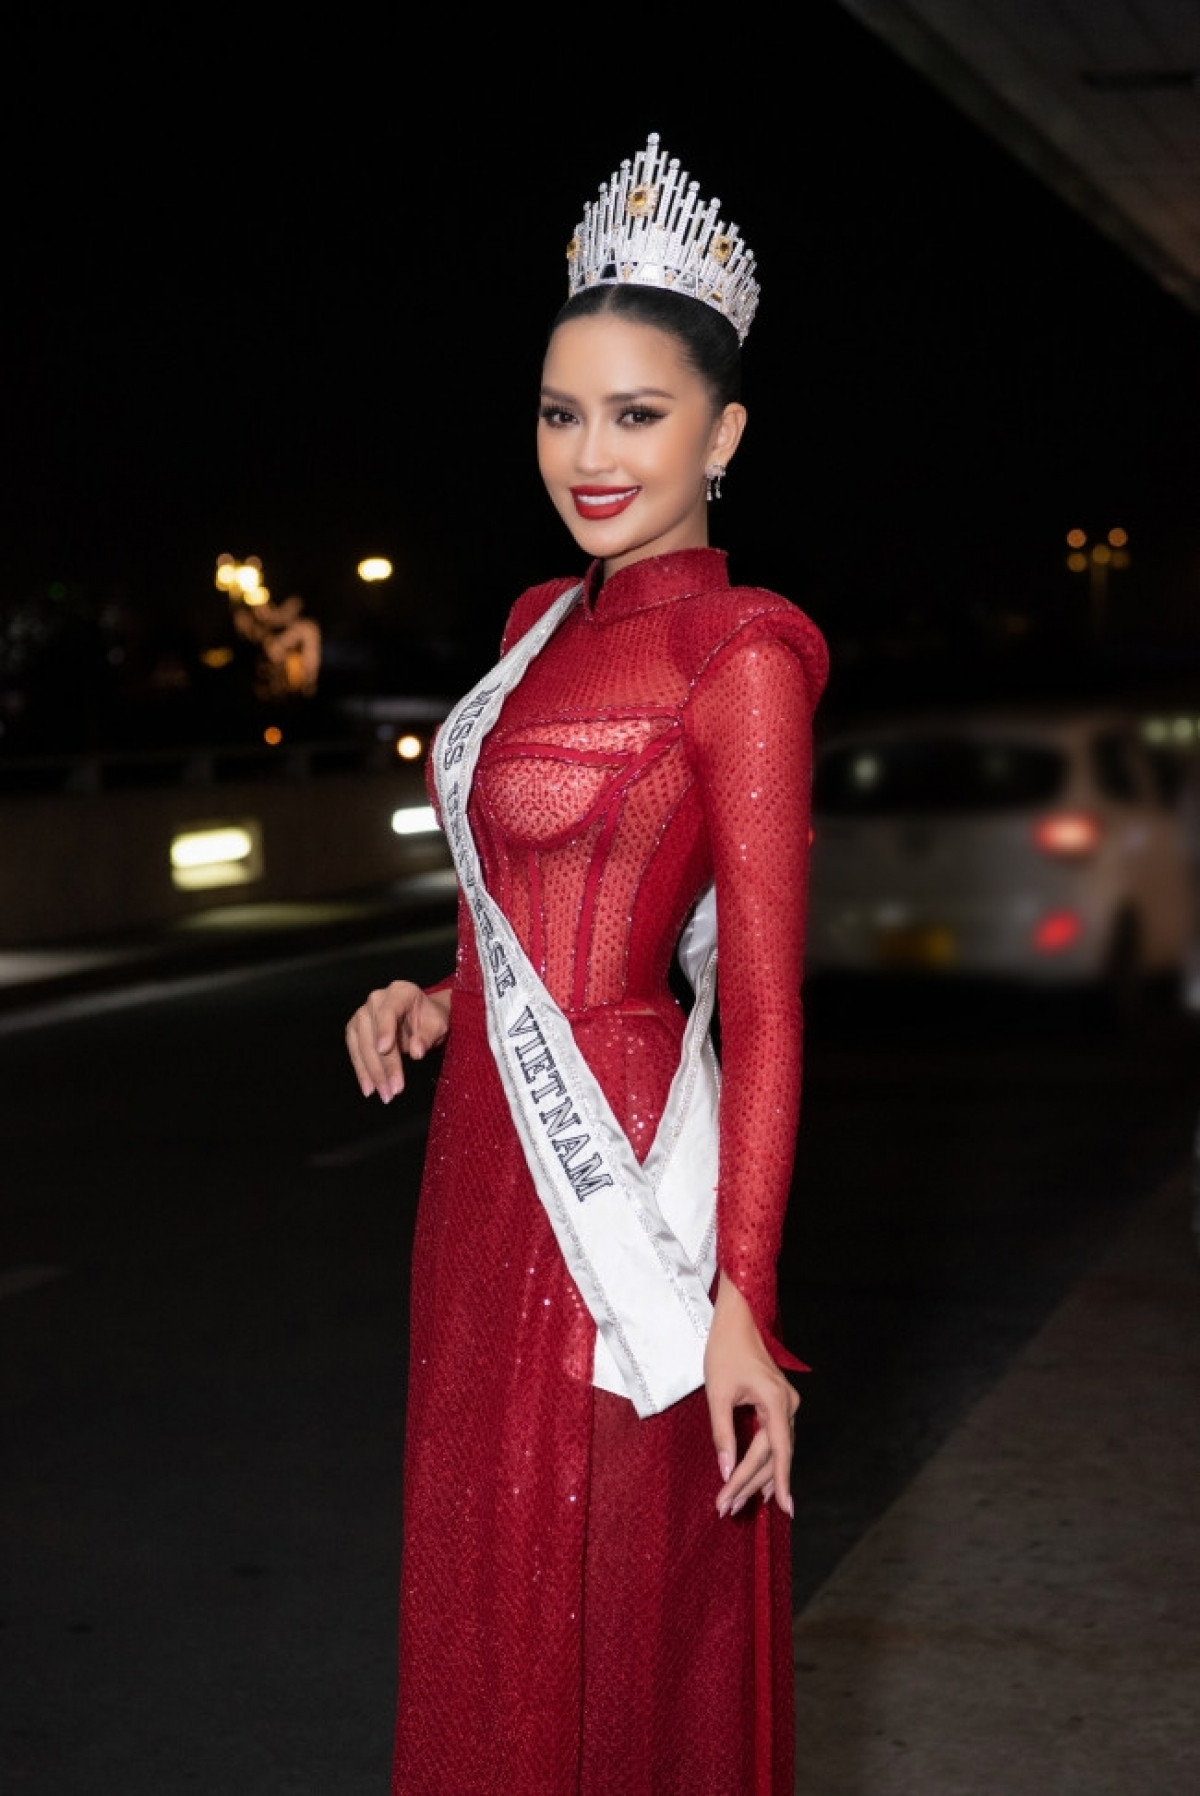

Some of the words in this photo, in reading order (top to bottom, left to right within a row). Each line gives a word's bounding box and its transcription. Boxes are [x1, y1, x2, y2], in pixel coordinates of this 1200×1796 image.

[443, 682, 502, 770] MISS
[447, 781, 517, 998] UERSE
[507, 1005, 614, 1202] VIETNAM
